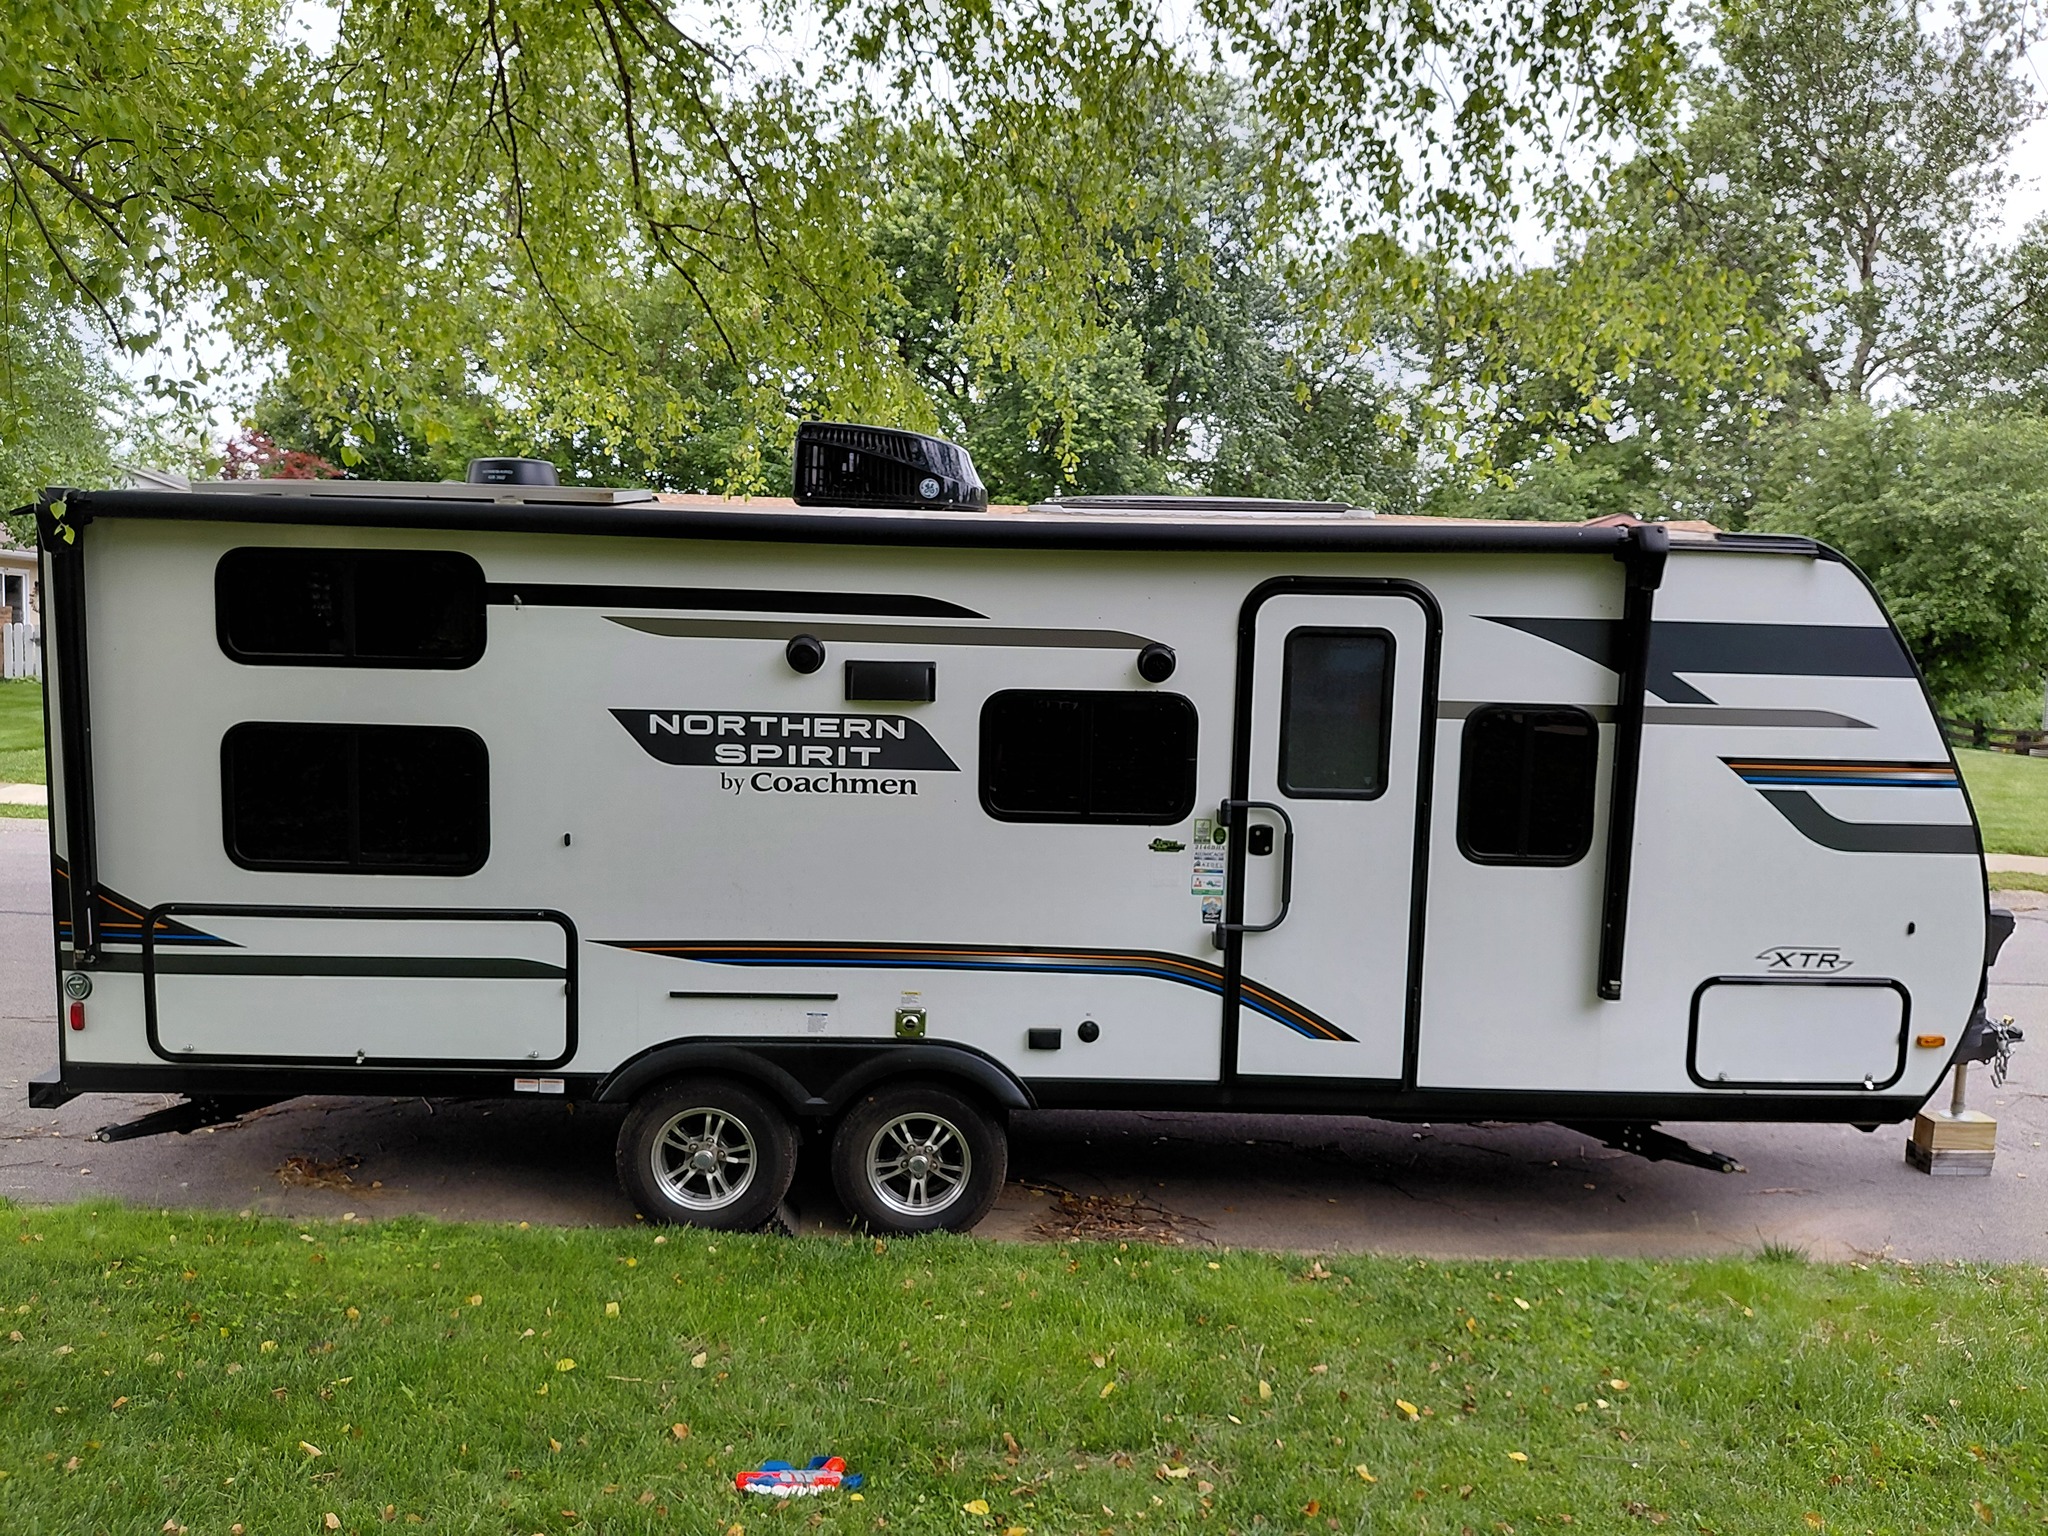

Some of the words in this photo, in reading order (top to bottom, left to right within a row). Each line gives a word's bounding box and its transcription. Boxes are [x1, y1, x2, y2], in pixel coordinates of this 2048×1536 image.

[649, 713, 906, 740] NORTHERN
[714, 743, 882, 767] SPIRIT
[720, 772, 744, 795] by
[750, 772, 919, 796] Coachmen
[1769, 952, 1841, 969] XTR
